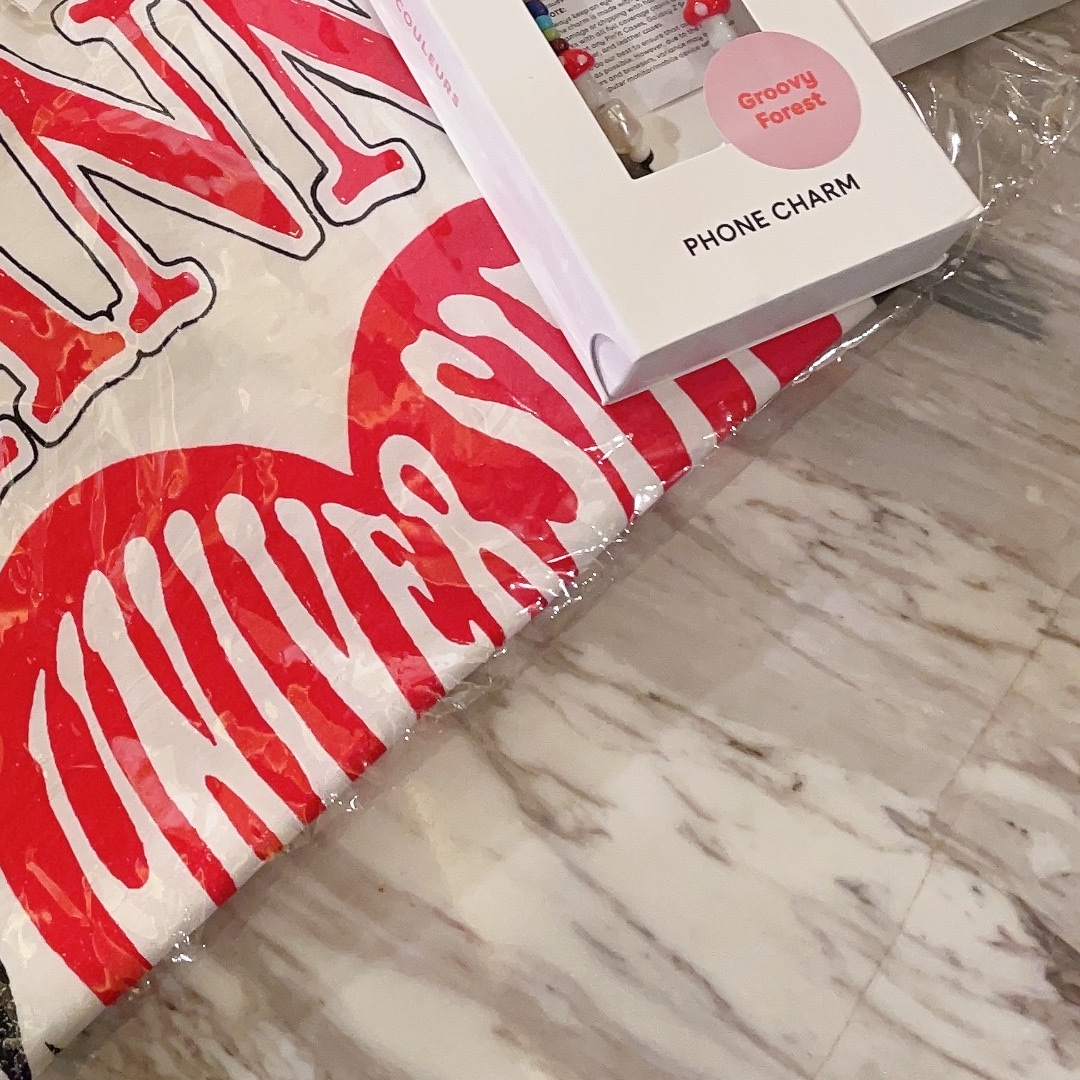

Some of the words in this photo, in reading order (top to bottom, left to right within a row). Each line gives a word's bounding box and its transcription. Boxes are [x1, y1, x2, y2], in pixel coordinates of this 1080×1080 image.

[736, 69, 819, 112] Groovy
[754, 91, 827, 131] Forest
[682, 208, 771, 258] PHONE
[770, 173, 861, 223] CHARM
